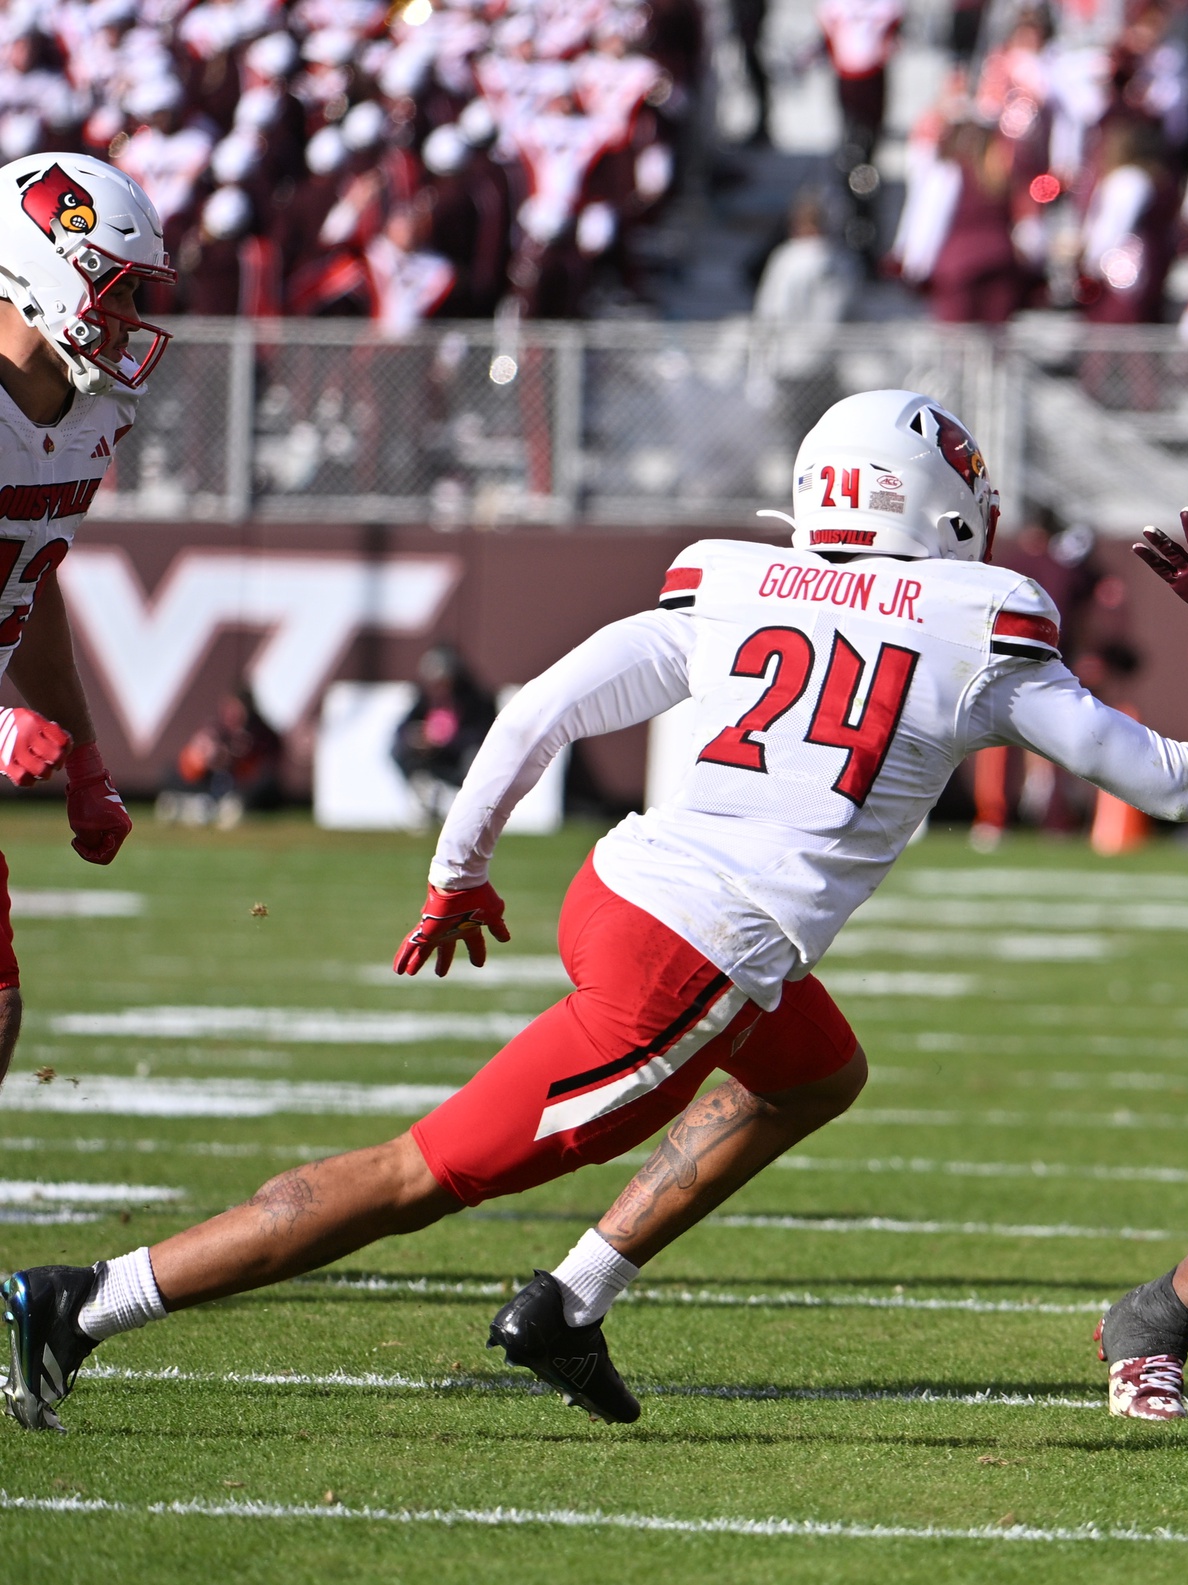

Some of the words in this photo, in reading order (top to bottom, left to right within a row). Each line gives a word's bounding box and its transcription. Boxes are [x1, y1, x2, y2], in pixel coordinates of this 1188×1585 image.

[820, 465, 860, 509] 24
[809, 529, 877, 546] LOUISVILLE
[758, 563, 876, 611] GORDON
[878, 578, 924, 624] JR.
[57, 545, 463, 758] VT
[695, 625, 921, 809] 24
